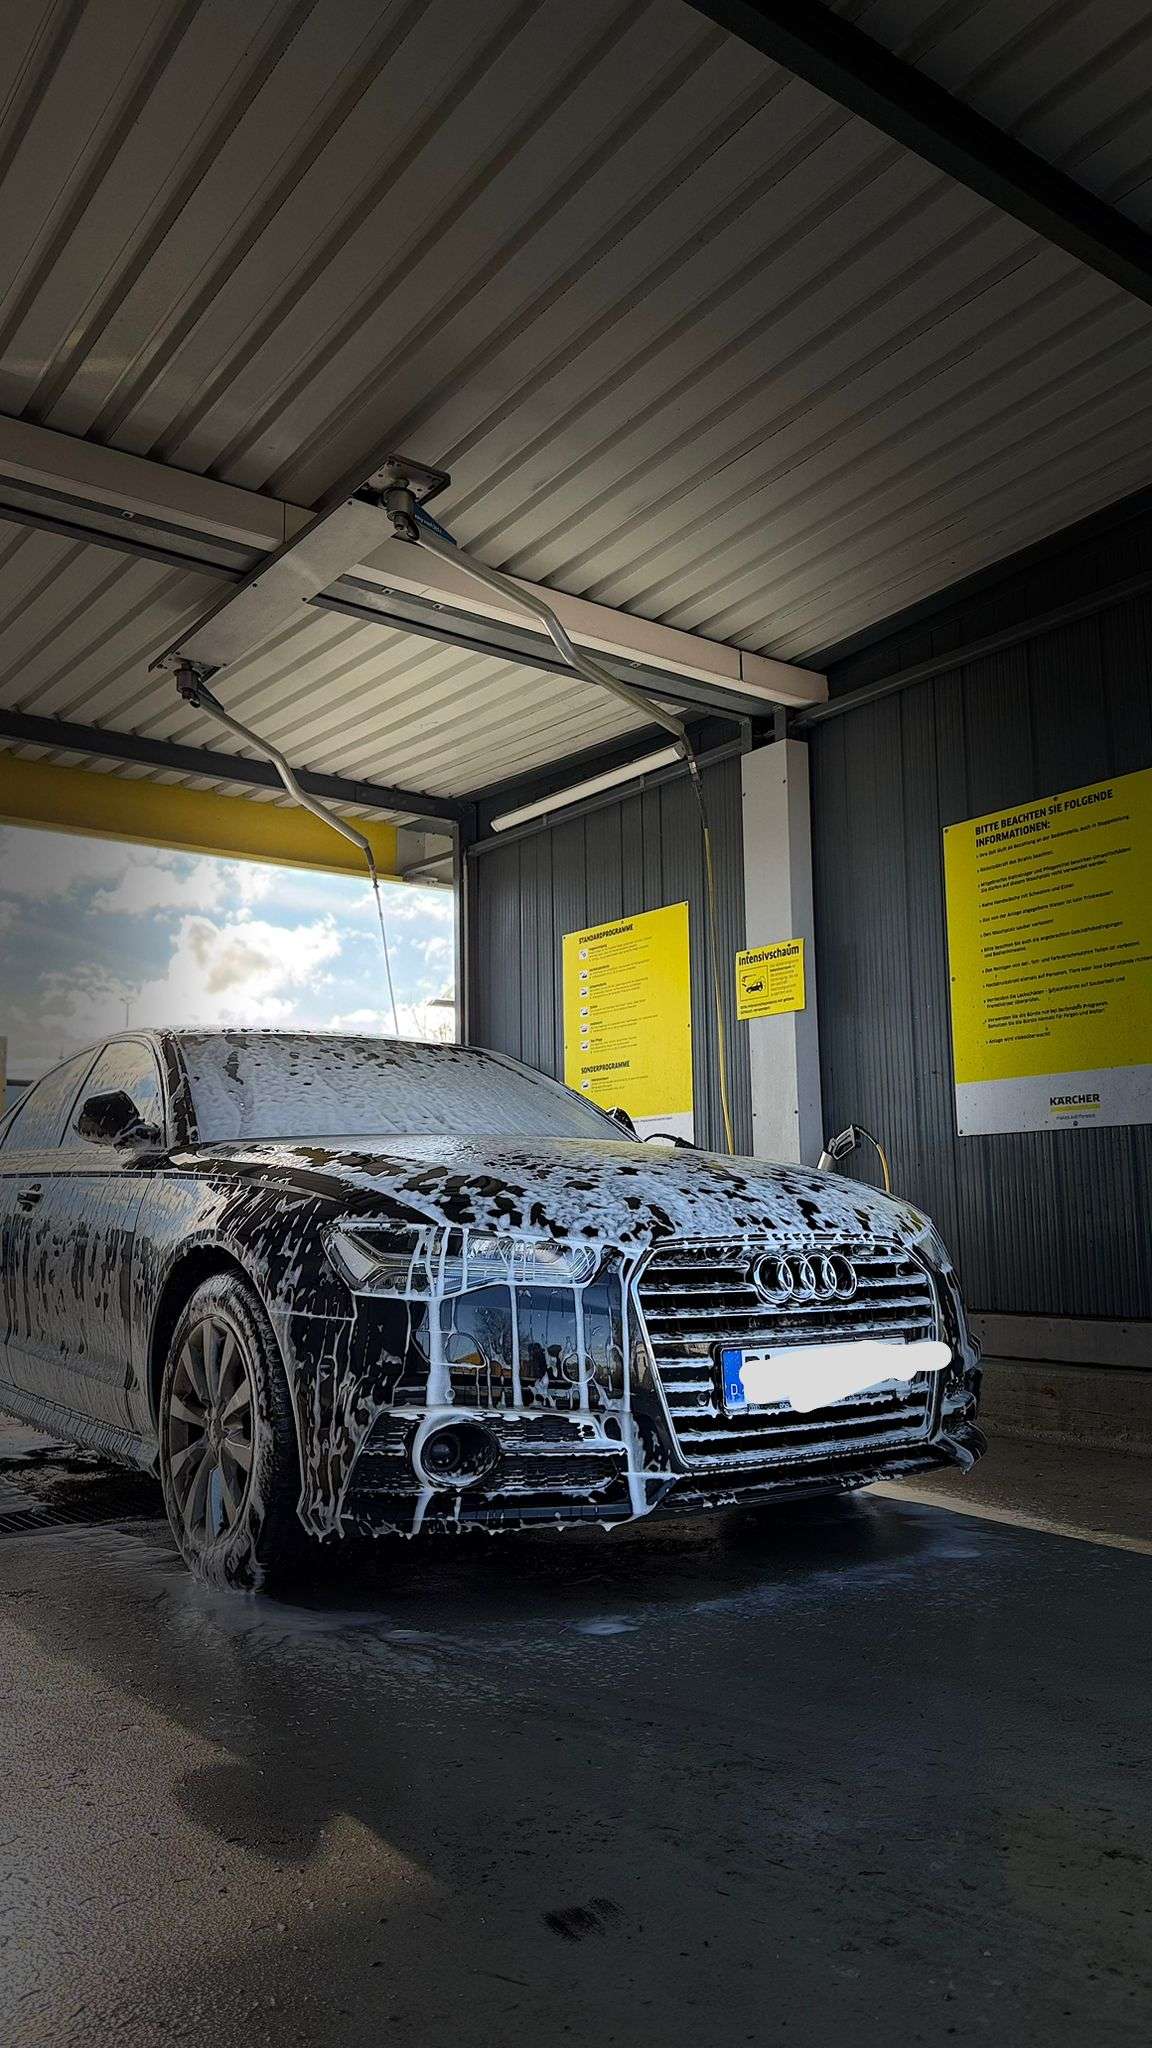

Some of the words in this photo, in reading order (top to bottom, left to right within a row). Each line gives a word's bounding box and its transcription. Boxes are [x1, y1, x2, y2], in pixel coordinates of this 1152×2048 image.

[975, 821, 1000, 836] BITTE
[1000, 808, 1047, 829] BEACHTEN
[1048, 804, 1063, 816] SIE
[1064, 789, 1114, 811] FOLGENDE
[976, 821, 1051, 848] INFORMATIONEN:
[579, 923, 634, 945] STANDARDPROGRAMME
[739, 945, 800, 966] Intensivschaum
[581, 1060, 631, 1075] SONDERPROGRAMME
[1049, 1093, 1100, 1106] KÄRCHER
[730, 1383, 739, 1396] D
